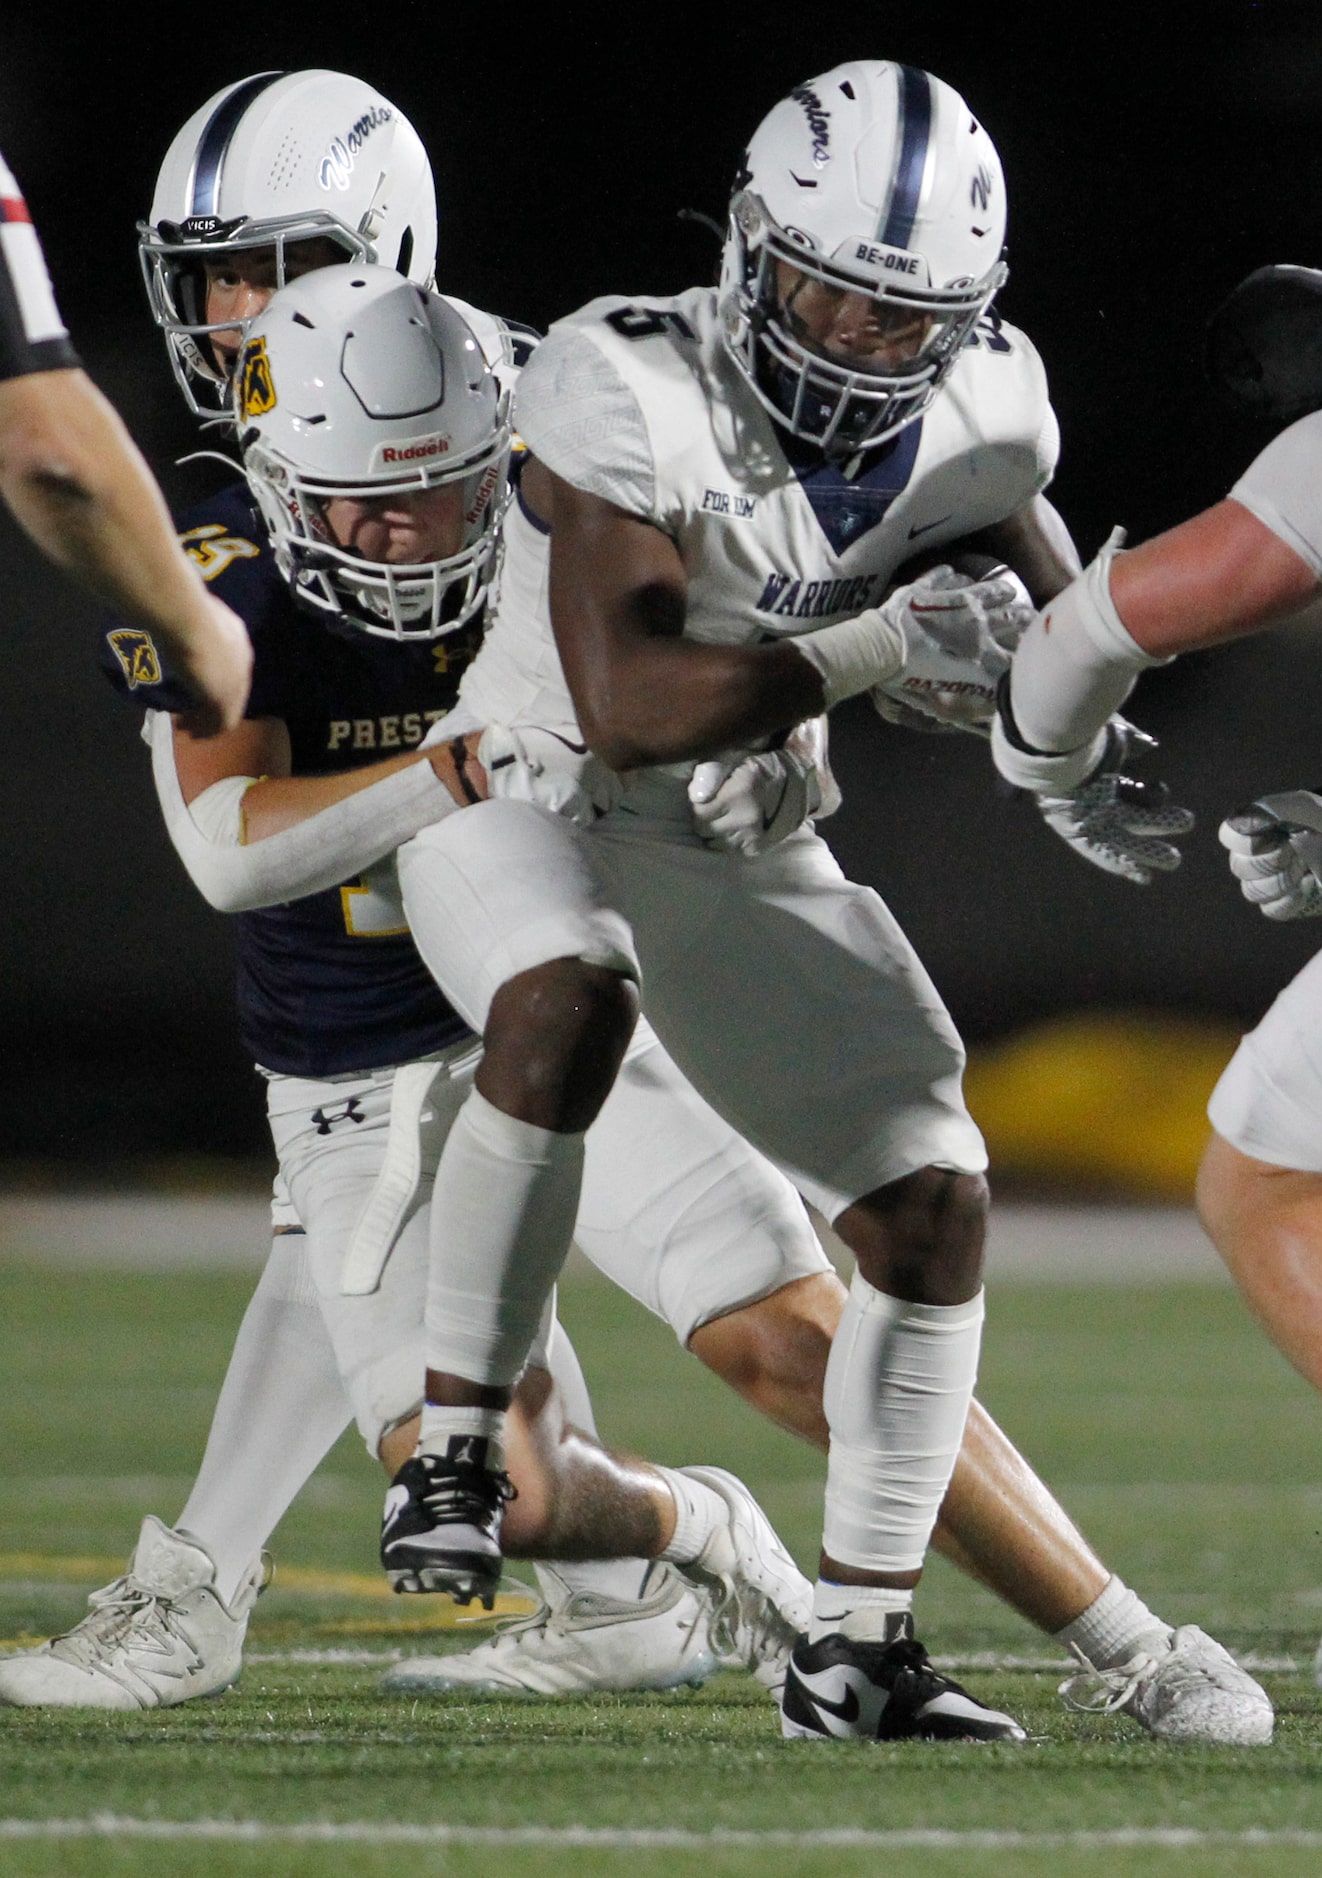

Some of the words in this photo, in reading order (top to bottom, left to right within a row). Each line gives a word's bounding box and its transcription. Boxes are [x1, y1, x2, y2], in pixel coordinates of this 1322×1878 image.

[187, 219, 216, 231] VICIS
[856, 243, 919, 275] BE-ONE
[178, 336, 203, 367] ICIS
[702, 489, 729, 513] FOR
[756, 572, 879, 618] WARRIORS
